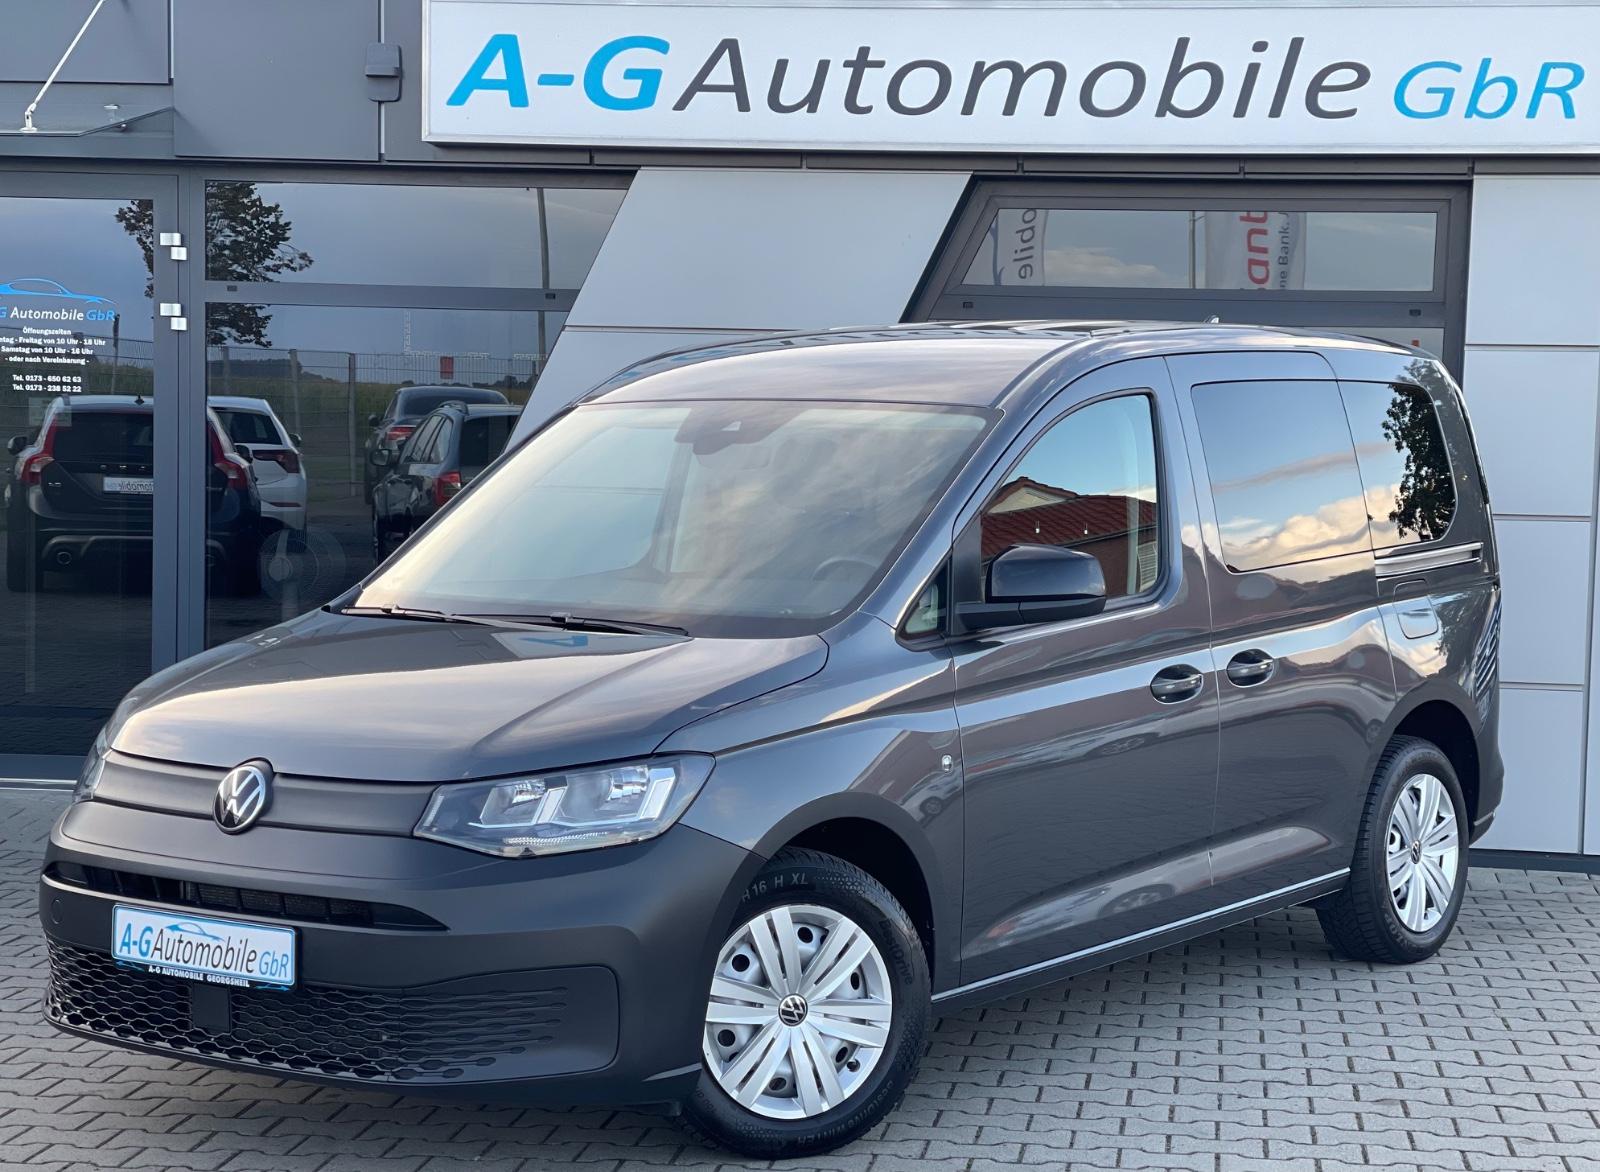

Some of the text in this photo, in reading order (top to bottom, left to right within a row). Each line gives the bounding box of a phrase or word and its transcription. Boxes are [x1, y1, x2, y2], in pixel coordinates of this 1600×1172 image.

[446, 33, 1585, 119] A-G Automobile GbR
[1239, 211, 1270, 288] ant
[10, 306, 84, 321] Automobile
[86, 309, 115, 321] GbR
[23, 326, 71, 335] Öffnungszeiten
[19, 336, 42, 345] Freitag
[56, 337, 65, 345] 10
[67, 337, 78, 345] Uhr
[94, 338, 106, 346] Uhr
[1, 346, 30, 354] Samstag
[44, 346, 53, 354] 10
[81, 347, 94, 355] Uhr
[42, 356, 86, 366] Vereinbarung
[25, 374, 43, 382] 0173
[62, 375, 71, 383] 62
[72, 385, 82, 393] 22
[774, 873, 784, 889] H
[791, 872, 809, 885] XL
[119, 922, 290, 978] A-G Automobile GbR
[148, 965, 250, 987] A-G AUTOMOBILE GEORGSHEIL
